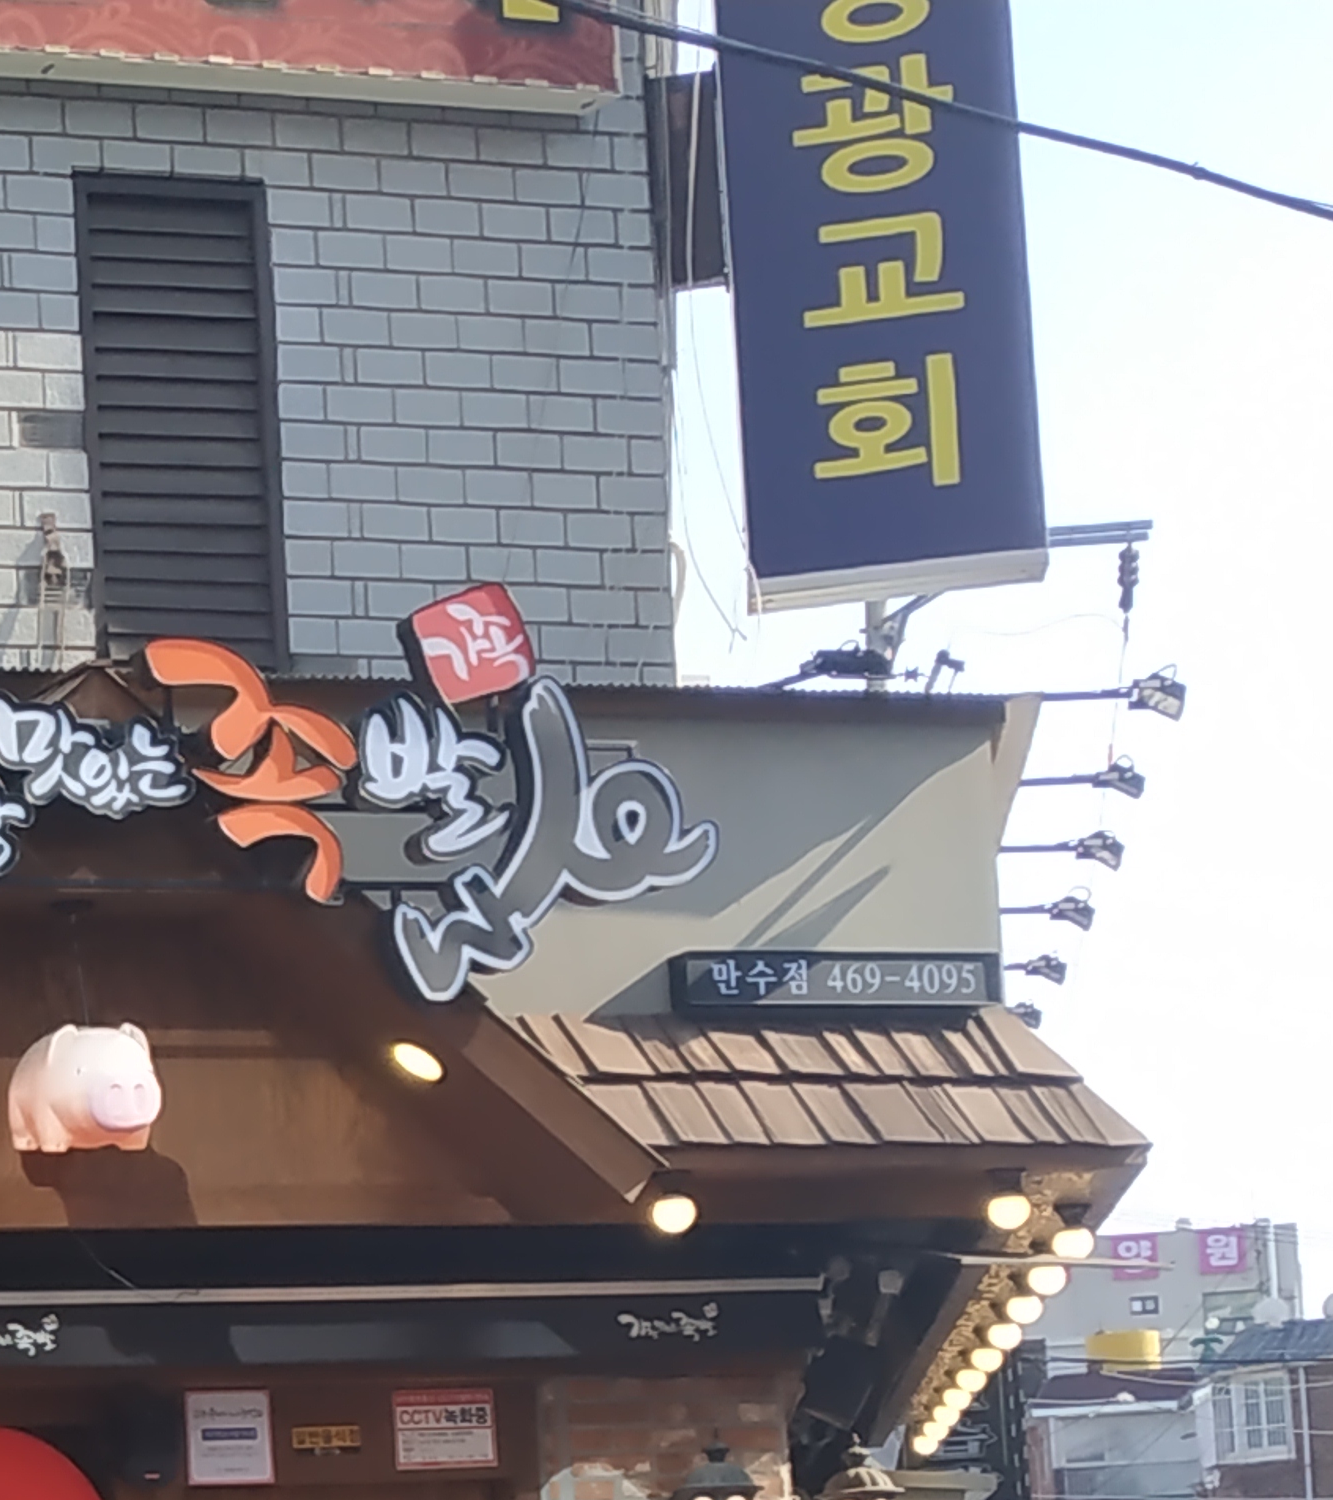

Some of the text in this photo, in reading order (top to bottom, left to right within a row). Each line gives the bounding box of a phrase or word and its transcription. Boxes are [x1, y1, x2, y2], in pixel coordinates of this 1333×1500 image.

[143, 636, 508, 904] 족발
[710, 958, 978, 996] 만수점 469-4095
